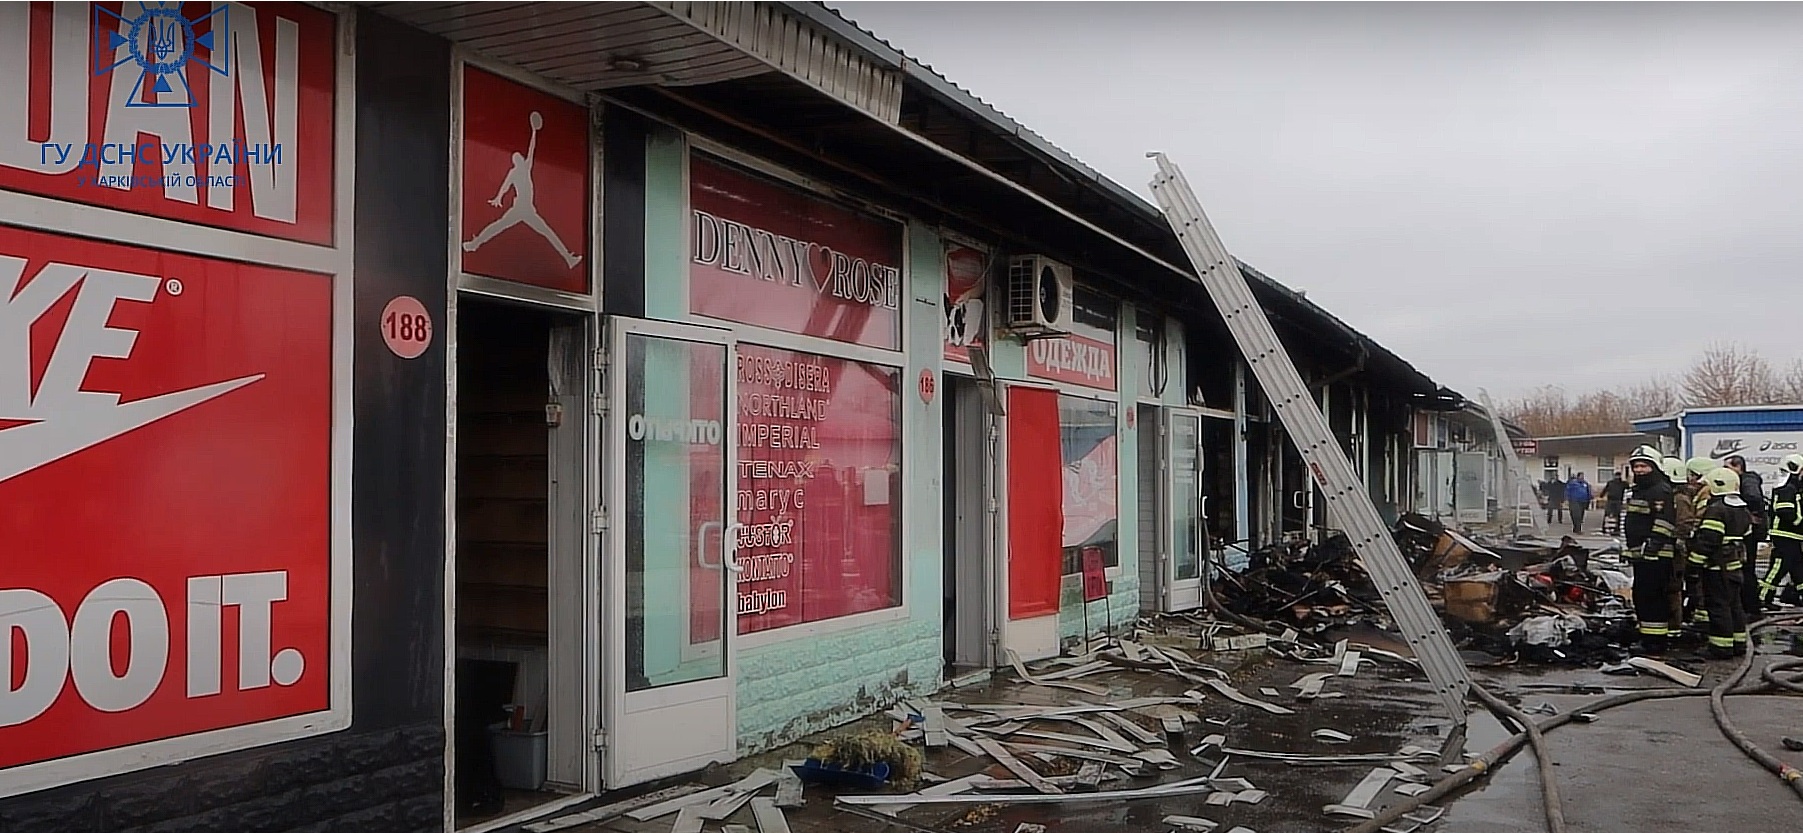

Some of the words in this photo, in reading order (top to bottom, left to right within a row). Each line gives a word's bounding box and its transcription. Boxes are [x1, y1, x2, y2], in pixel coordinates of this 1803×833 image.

[693, 209, 810, 288] DENNY
[832, 250, 900, 311] ROSE
[386, 311, 427, 342] 188
[1032, 338, 1111, 382] ОДЕЖДА
[1715, 438, 1744, 451] NIKE
[738, 460, 815, 479] TENAX
[737, 488, 790, 515] mary
[737, 588, 787, 615] babylon
[0, 577, 169, 728] DO
[186, 570, 305, 698] IT.
